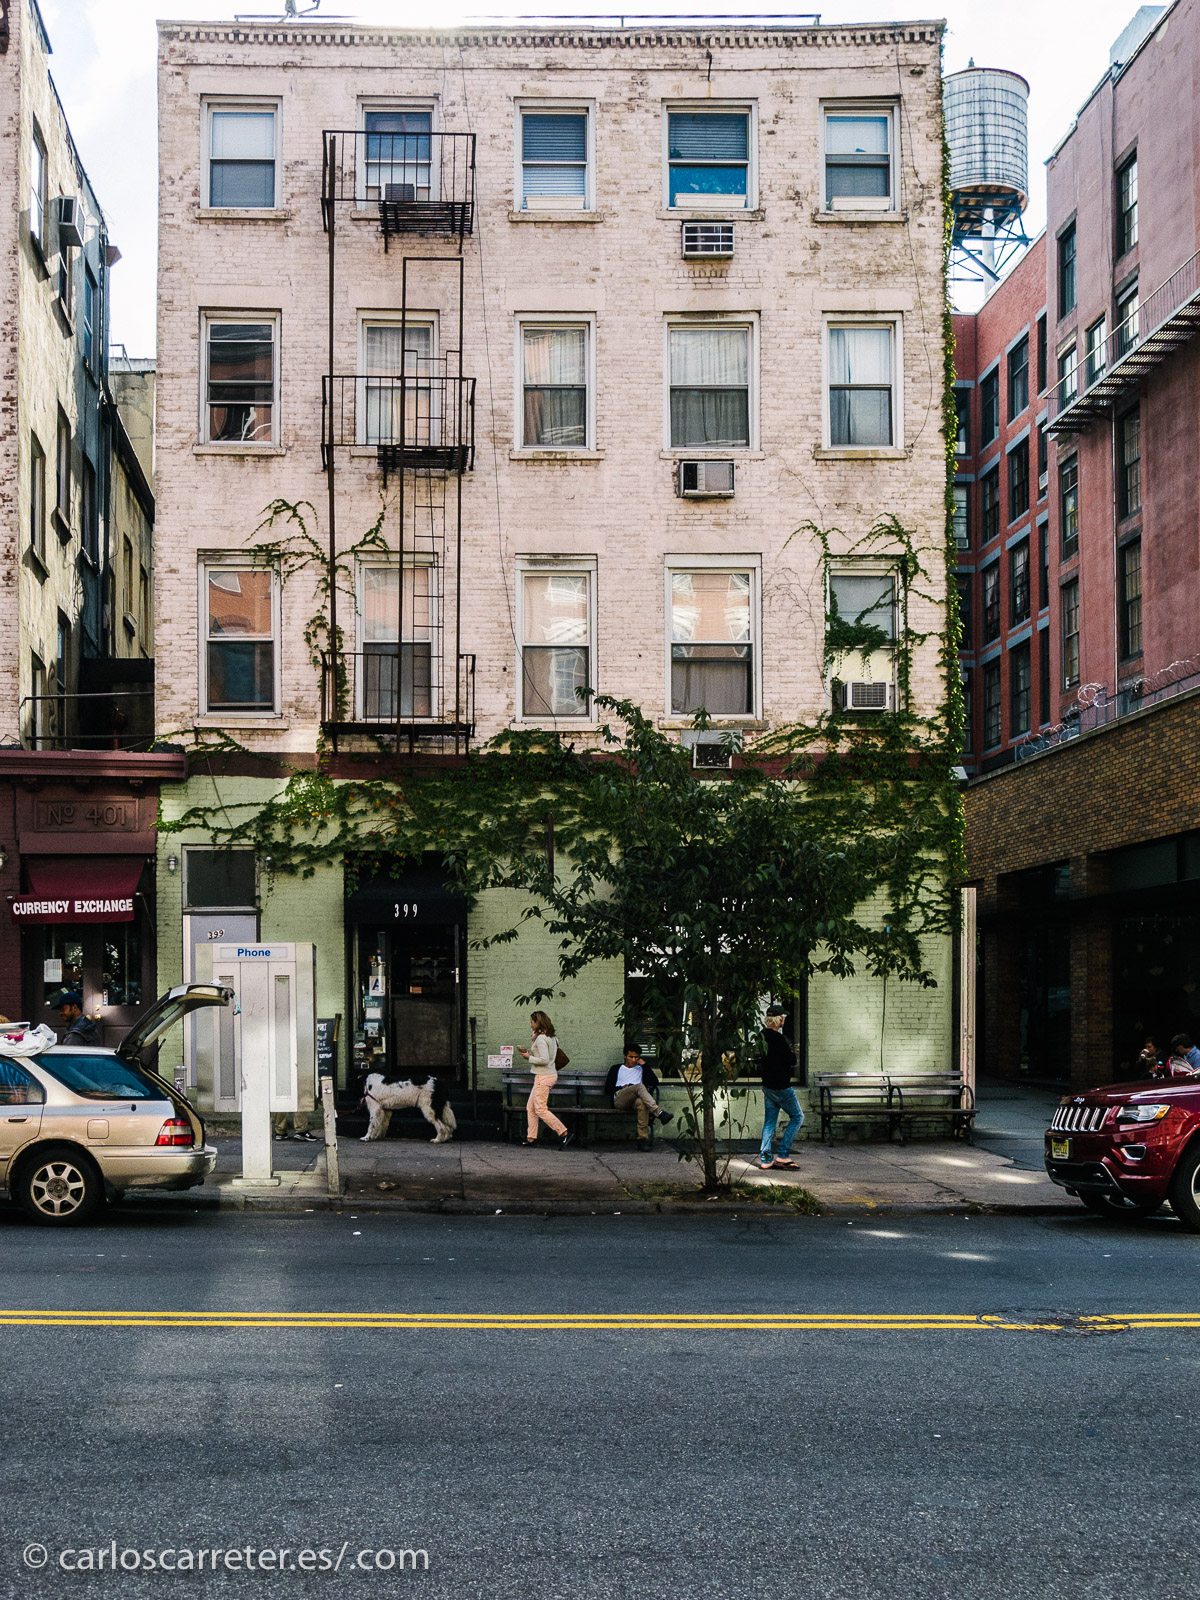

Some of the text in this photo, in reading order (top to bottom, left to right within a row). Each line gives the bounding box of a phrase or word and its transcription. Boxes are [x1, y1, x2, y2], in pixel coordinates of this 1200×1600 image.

[86, 804, 126, 825] 401
[12, 899, 133, 915] CURRENCY EXCHANGE
[394, 903, 418, 918] 399
[207, 929, 225, 940] 399
[237, 948, 271, 957] Phone
